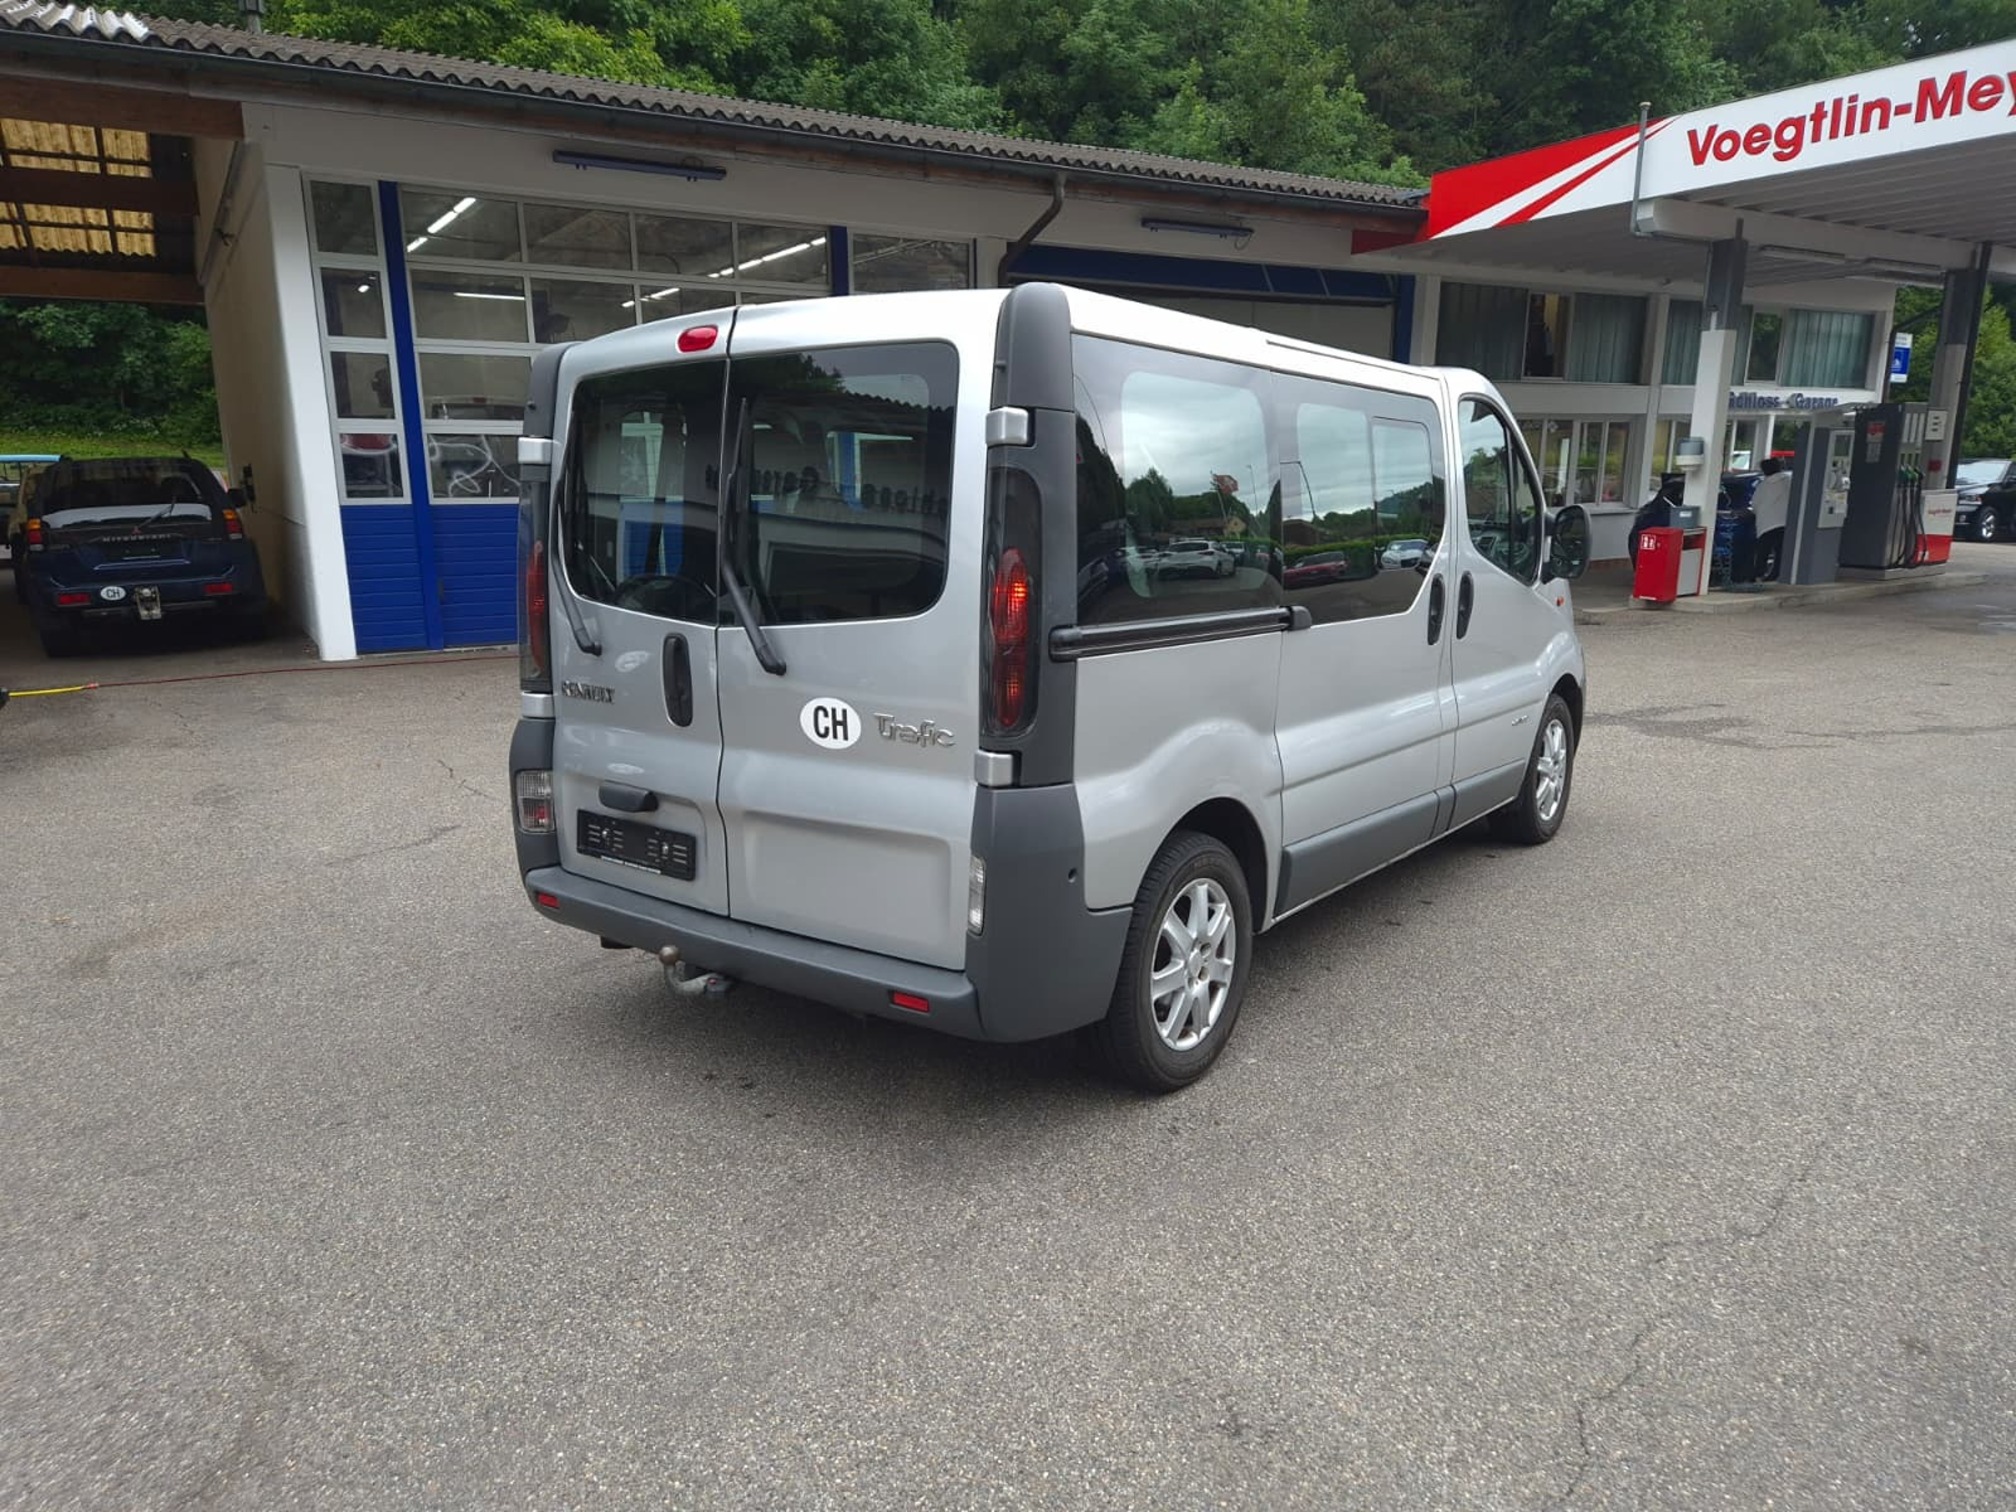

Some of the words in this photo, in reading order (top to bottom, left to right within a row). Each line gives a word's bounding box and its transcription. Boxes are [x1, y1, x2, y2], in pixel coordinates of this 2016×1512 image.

[1687, 69, 2016, 167] Voegtlin-Me
[106, 588, 120, 599] CH
[812, 704, 849, 741] CH
[872, 712, 956, 748] Trafic
